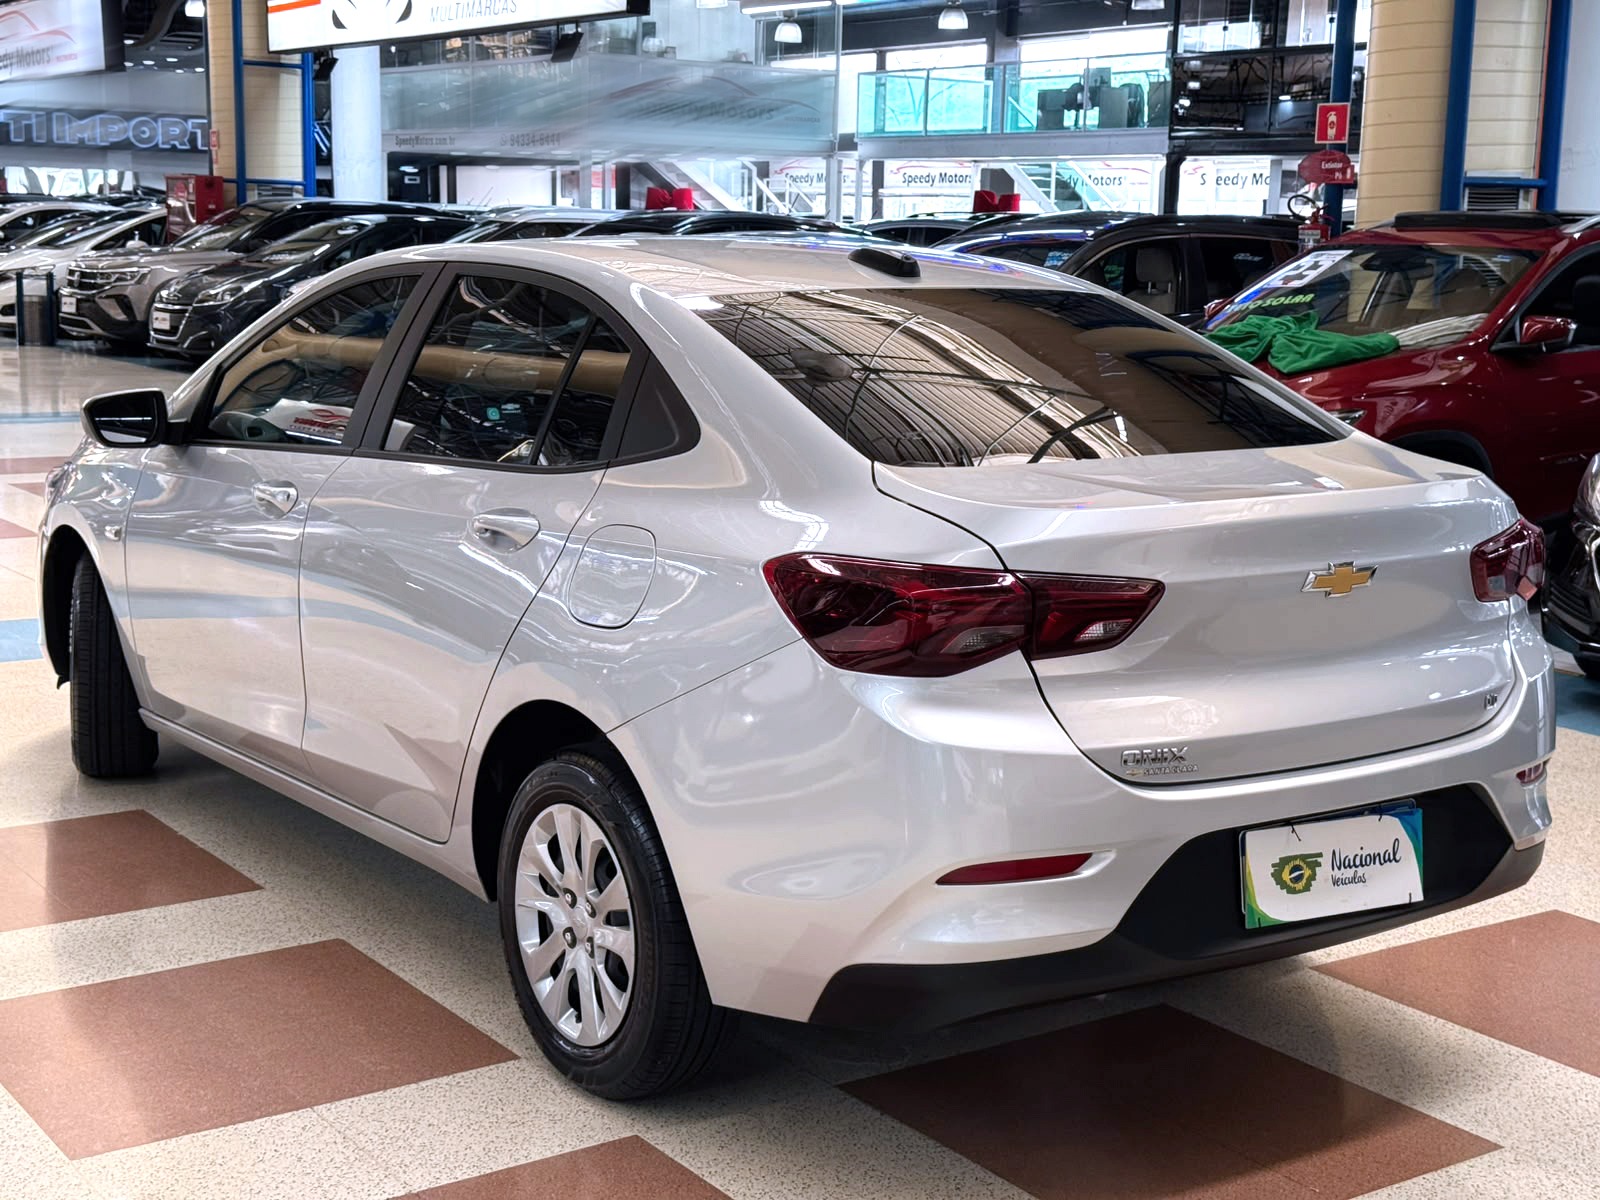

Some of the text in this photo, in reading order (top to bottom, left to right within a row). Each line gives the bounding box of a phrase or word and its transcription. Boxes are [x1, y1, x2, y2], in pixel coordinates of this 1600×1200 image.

[430, 0, 517, 22] MULTIMARCAS
[902, 172, 937, 187] Speedy
[1200, 172, 1248, 190] Seedy
[1121, 746, 1188, 768] ONIX
[1144, 766, 1170, 776] SANTA
[1331, 838, 1402, 871] Nacional
[1331, 869, 1367, 887] Veículos
